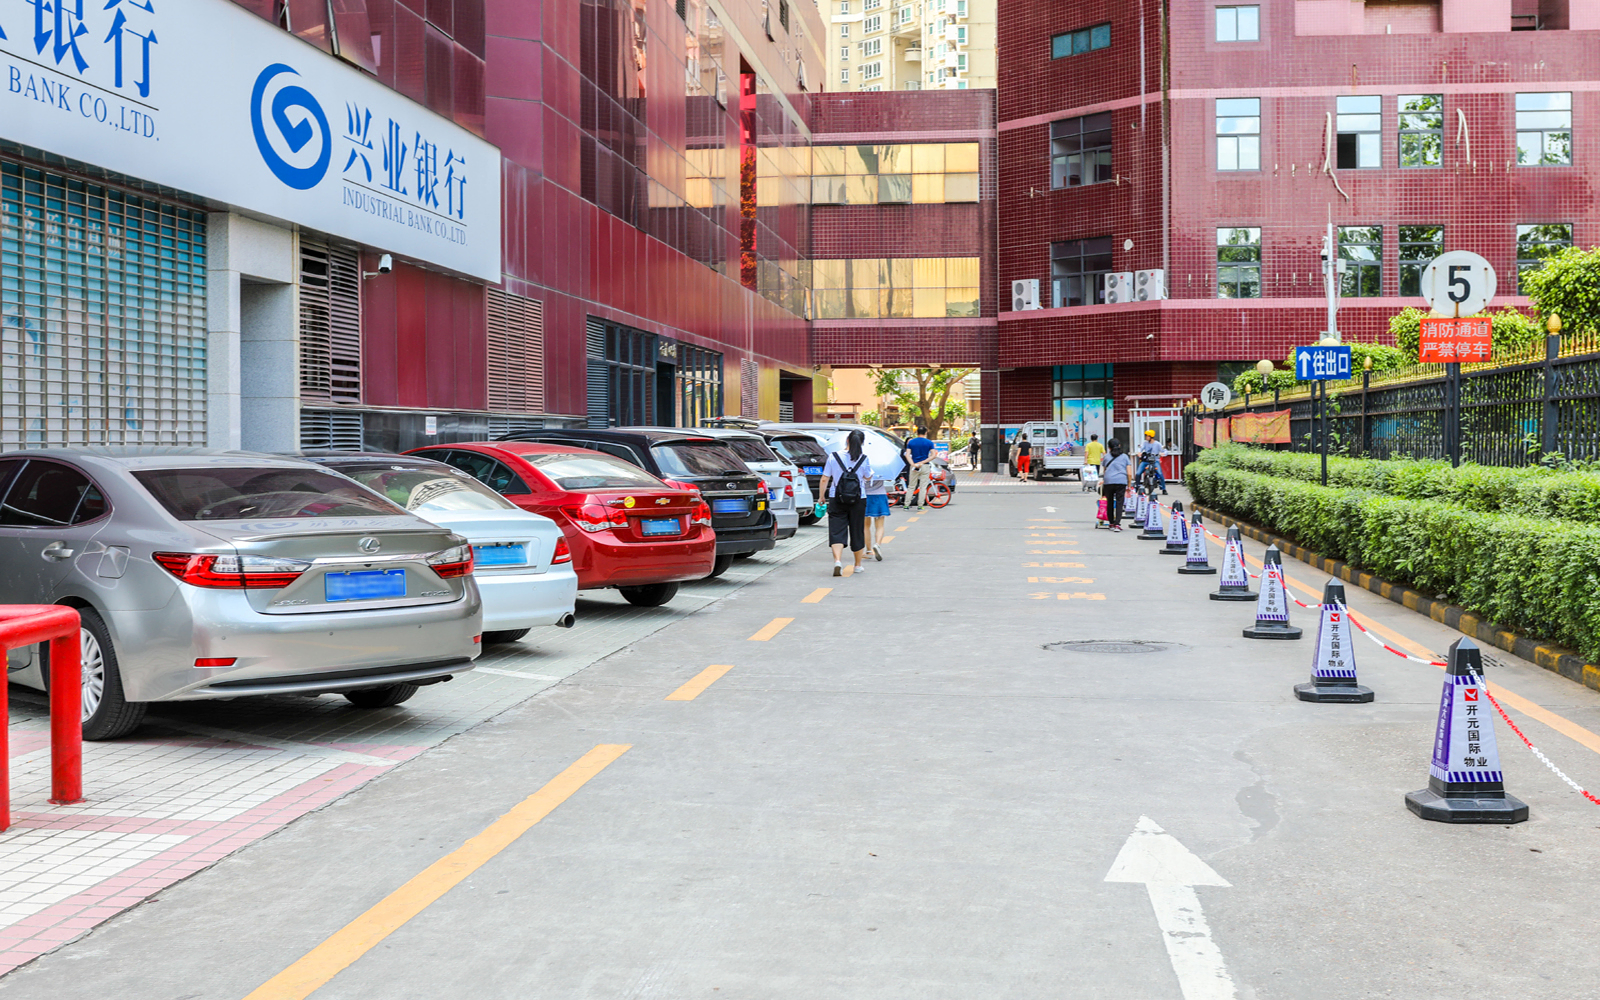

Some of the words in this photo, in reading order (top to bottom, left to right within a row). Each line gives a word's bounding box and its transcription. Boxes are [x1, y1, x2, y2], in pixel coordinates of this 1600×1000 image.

[0, 0, 158, 98] 银行
[8, 65, 72, 112] BANK
[79, 92, 160, 142] CO.,LTD.
[343, 100, 467, 220] 兴业银行
[343, 186, 405, 224] INDUSTRIAL
[408, 210, 433, 234] BANK
[1447, 265, 1472, 303] 5
[1422, 321, 1489, 338] 消防通道
[1312, 350, 1349, 376] 往出口
[1421, 341, 1489, 358] 严禁停车
[1207, 387, 1225, 405] 停
[1466, 704, 1482, 754] 开元国际
[1464, 756, 1488, 767] 物业
